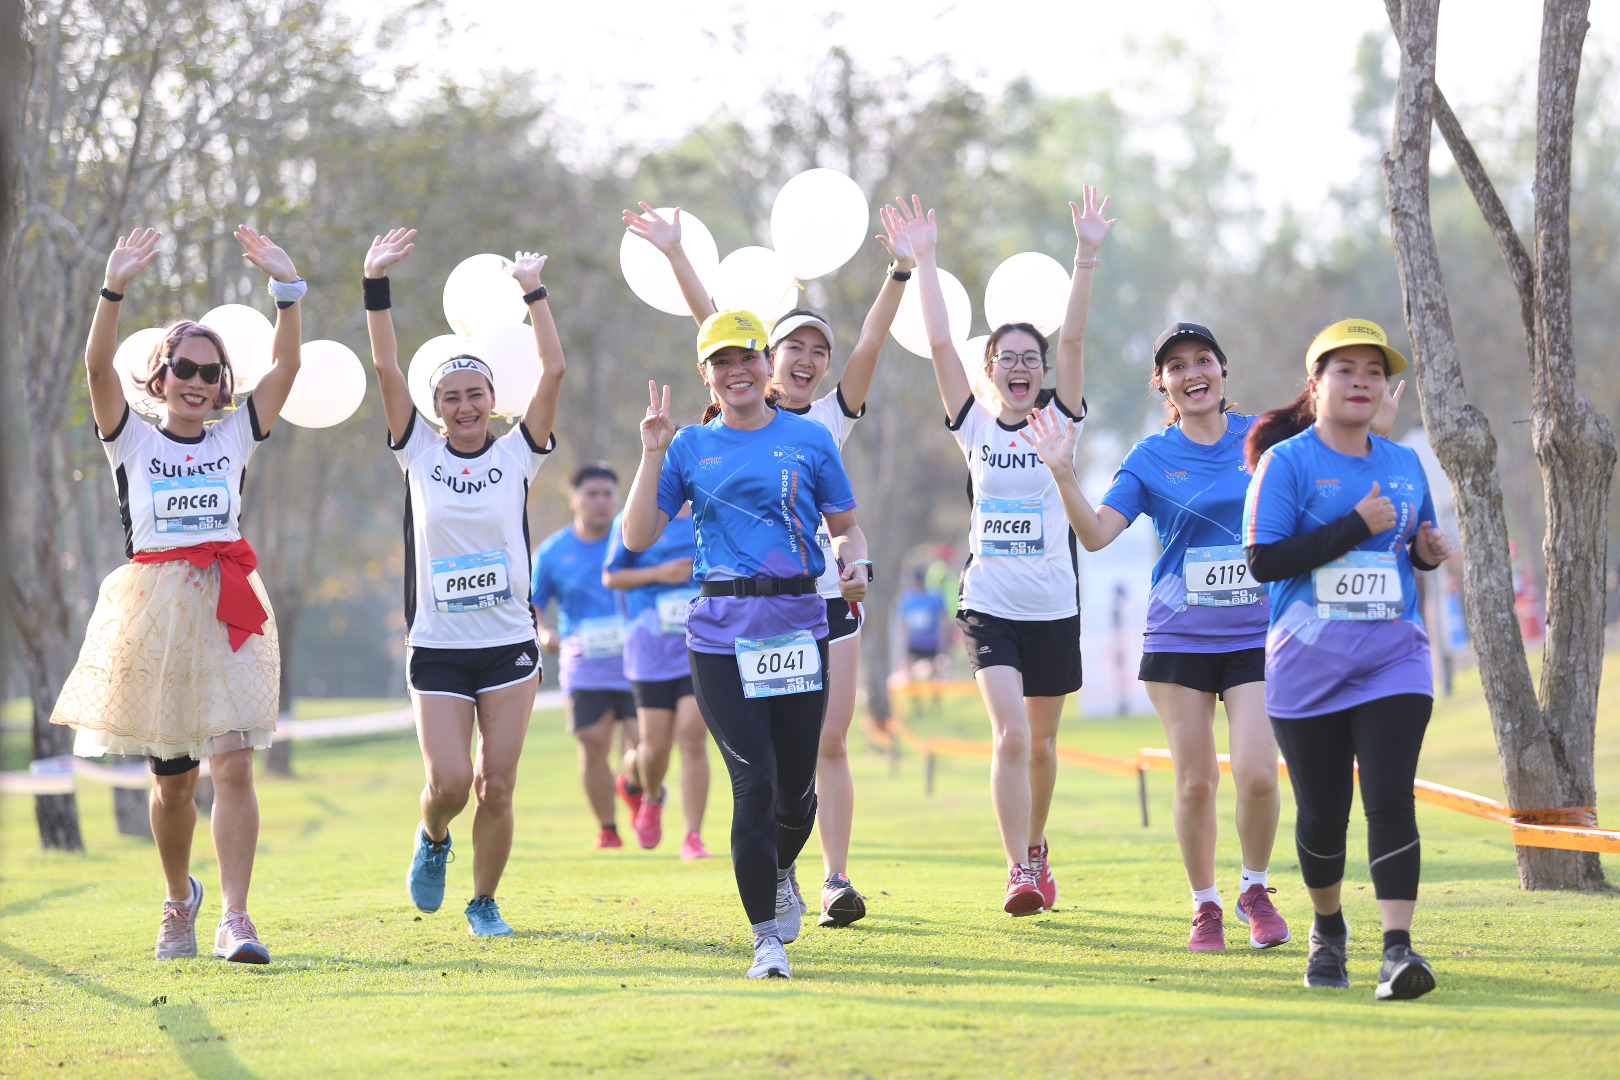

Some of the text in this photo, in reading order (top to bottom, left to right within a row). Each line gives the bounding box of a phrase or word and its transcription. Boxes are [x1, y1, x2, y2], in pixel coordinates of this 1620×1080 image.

[1347, 325, 1383, 341] SEIKO
[442, 360, 478, 375] FILA
[787, 470, 799, 508] SINGHA
[167, 493, 218, 511] PACER
[781, 468, 790, 498] CROSS
[788, 535, 798, 553] RUN
[983, 519, 1031, 534] PACER
[446, 571, 496, 593] PACER
[1205, 563, 1247, 586] 6119
[1336, 573, 1386, 595] 6071
[756, 649, 804, 675] 6041
